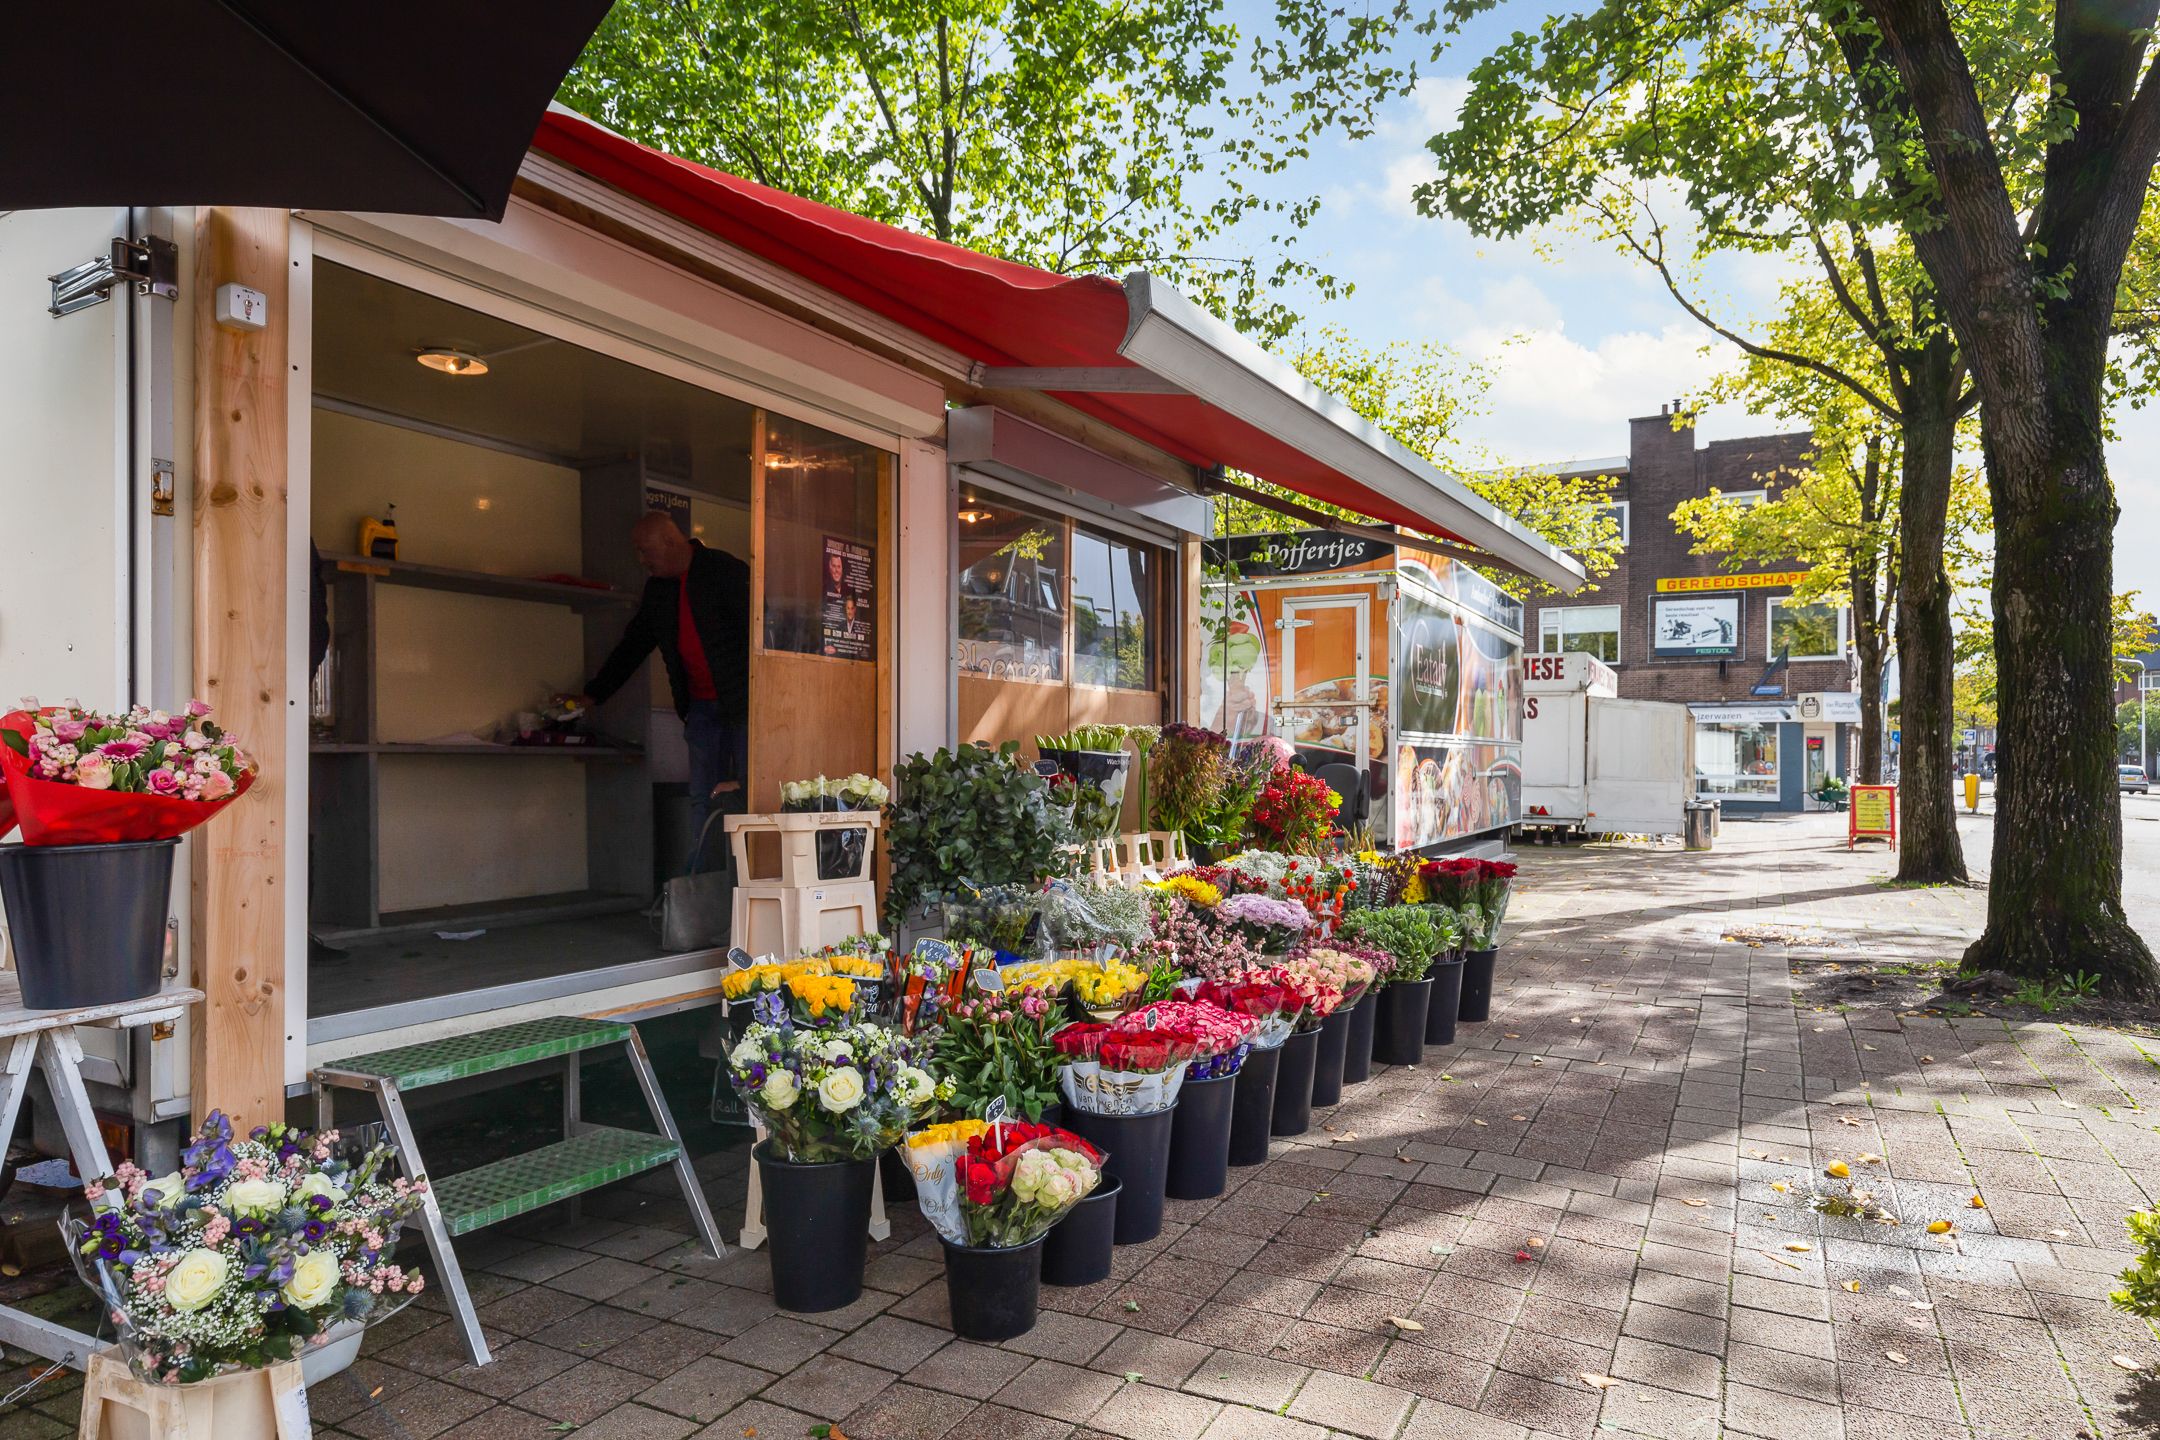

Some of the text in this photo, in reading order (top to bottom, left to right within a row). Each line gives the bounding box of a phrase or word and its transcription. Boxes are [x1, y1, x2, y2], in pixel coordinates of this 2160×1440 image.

[1264, 537, 1365, 571] Poffertjes
[1416, 640, 1447, 700] Eataly
[913, 1163, 946, 1185] Only
